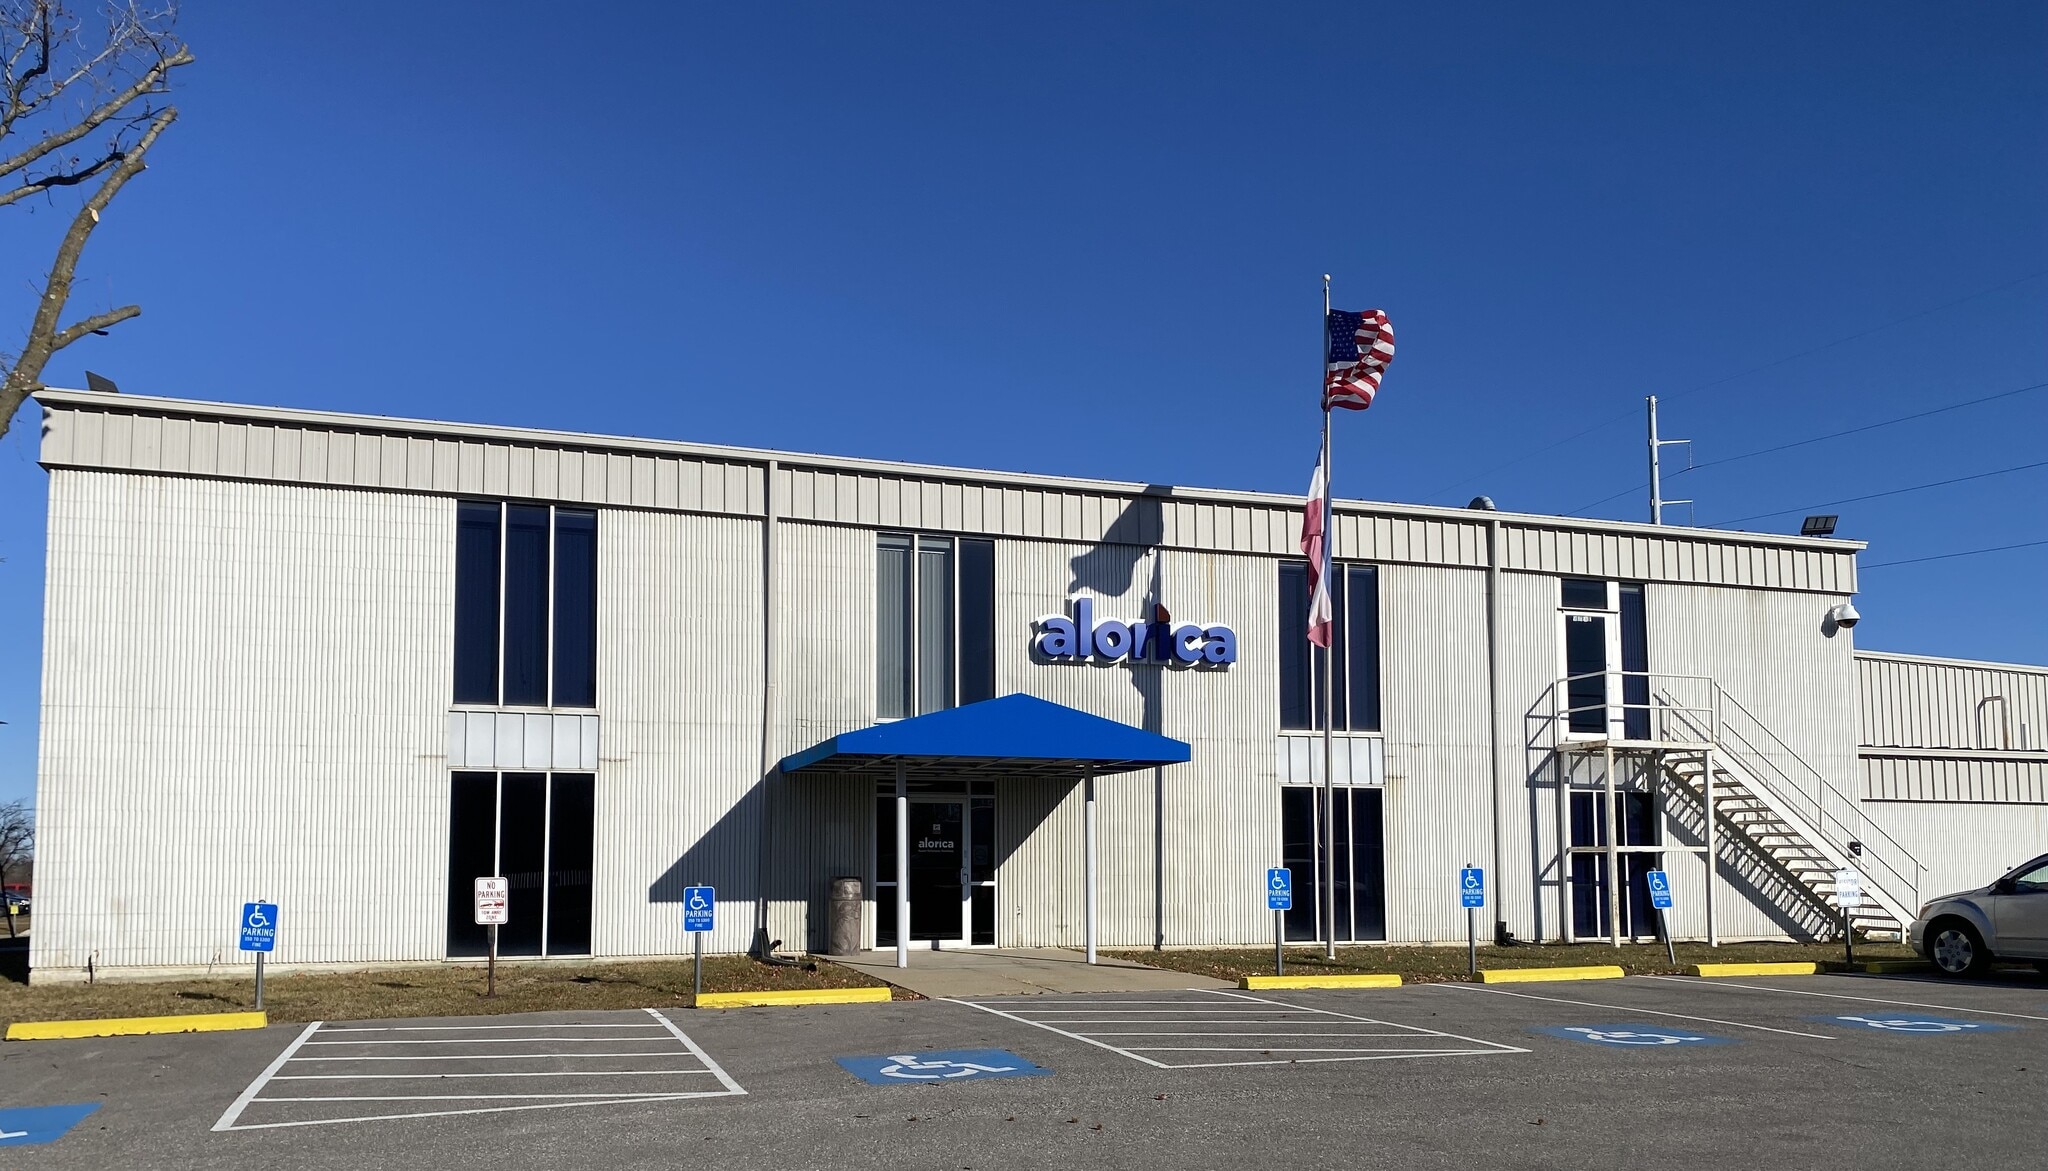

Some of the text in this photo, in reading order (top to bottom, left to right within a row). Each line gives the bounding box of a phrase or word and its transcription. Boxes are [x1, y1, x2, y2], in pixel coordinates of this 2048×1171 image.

[1037, 597, 1236, 664] alorica
[918, 837, 954, 848] alorica
[486, 881, 496, 890] NO
[478, 890, 505, 899] PARKING
[1269, 889, 1290, 897] PARKING
[1462, 888, 1483, 896] PARKING
[1840, 890, 1858, 898] PARKING
[685, 909, 713, 918] PARKING
[242, 927, 274, 937] PARKING
